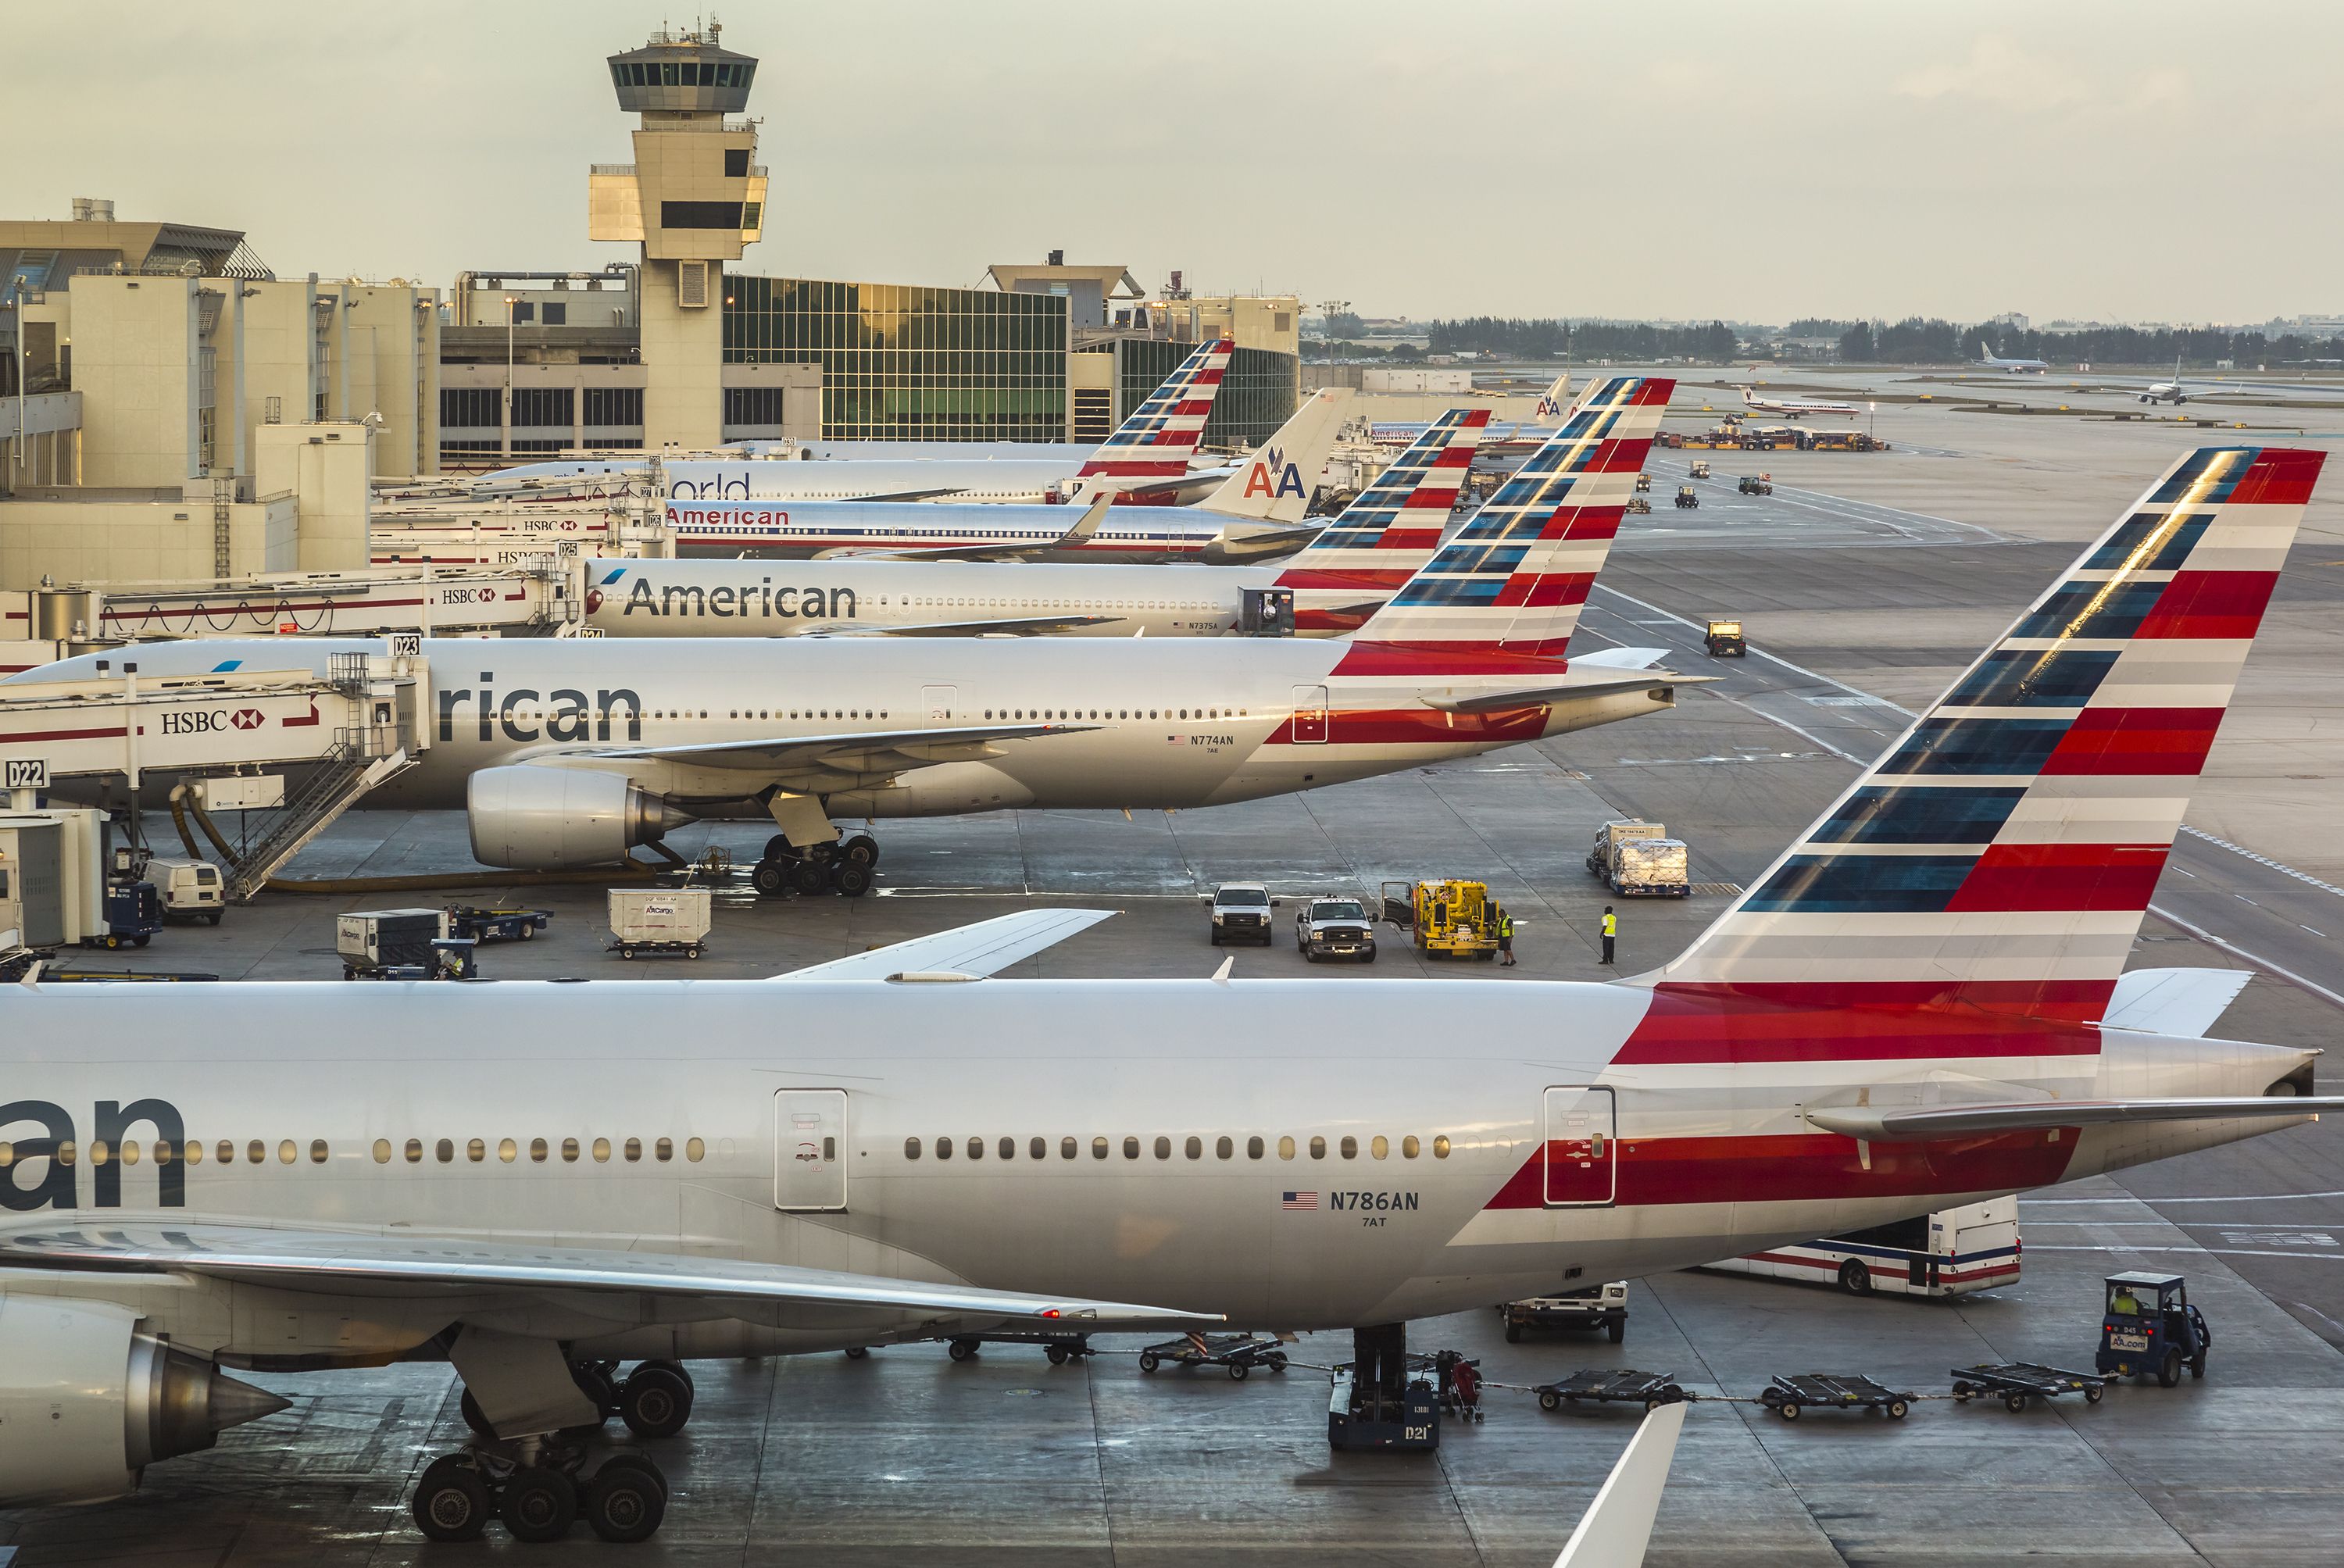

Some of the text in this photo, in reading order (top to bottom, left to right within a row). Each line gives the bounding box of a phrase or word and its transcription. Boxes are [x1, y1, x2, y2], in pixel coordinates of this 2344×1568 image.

[1536, 401, 1560, 416] AA
[1243, 462, 1306, 499] AA
[641, 487, 651, 497] D27
[649, 515, 661, 526] D26
[666, 507, 789, 526] American
[523, 520, 558, 531] HSBC
[560, 543, 577, 555] D25
[442, 588, 477, 604] HSBC
[623, 577, 856, 619] American
[395, 635, 419, 655] D23
[161, 709, 228, 735] HSBC
[1191, 735, 1234, 745] N774AN
[8, 761, 44, 787] D22
[1331, 1191, 1419, 1211] N786AN
[1362, 1217, 1387, 1227] 7AT
[2113, 1337, 2146, 1348] AA.com
[1405, 1427, 1427, 1440] D21
